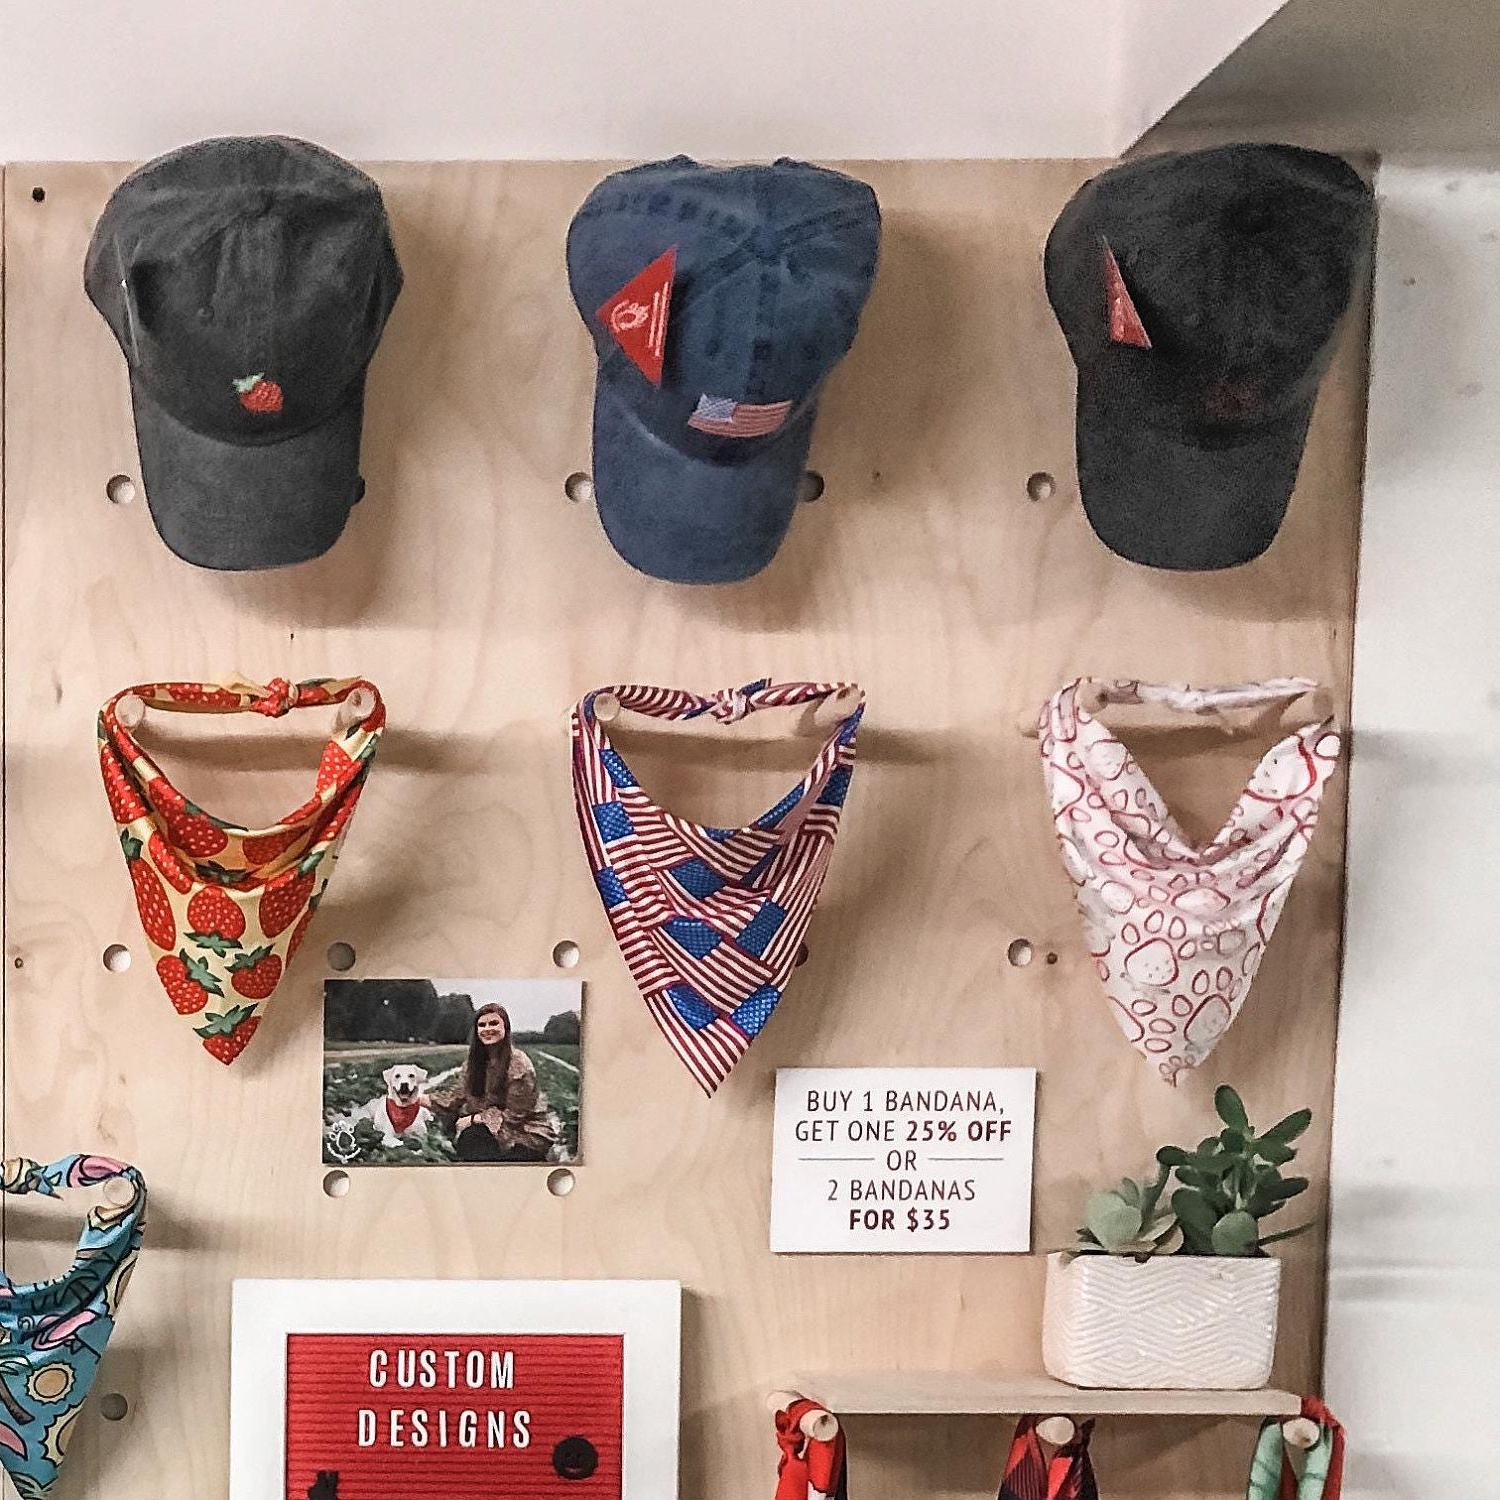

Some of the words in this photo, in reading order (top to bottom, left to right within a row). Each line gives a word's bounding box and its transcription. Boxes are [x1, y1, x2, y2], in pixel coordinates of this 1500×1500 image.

[807, 1090, 852, 1112] BUY
[863, 1091, 874, 1112] 1
[886, 1090, 1005, 1115] BANDANA,
[795, 1120, 839, 1142] GET
[847, 1120, 895, 1142] ONE
[906, 1120, 957, 1142] 25%
[968, 1120, 1012, 1142] OFF
[886, 1149, 917, 1171] OR
[827, 1179, 838, 1201] 2
[850, 1179, 976, 1201] BANDANAS
[850, 1209, 895, 1230] FOR
[906, 1206, 950, 1233] $35
[369, 1349, 514, 1389] CUSTOM
[358, 1409, 531, 1448] DESIGNS
